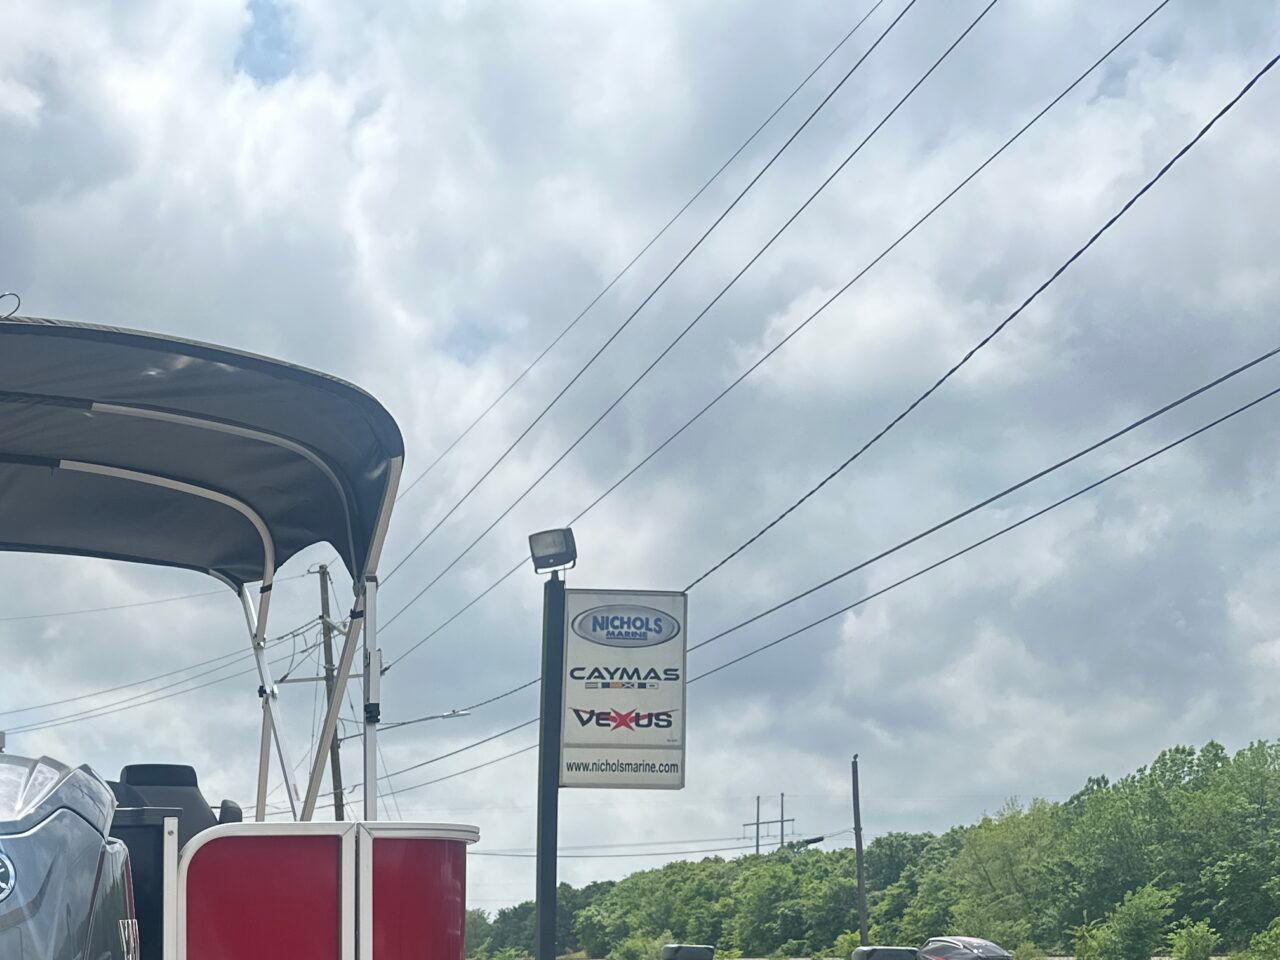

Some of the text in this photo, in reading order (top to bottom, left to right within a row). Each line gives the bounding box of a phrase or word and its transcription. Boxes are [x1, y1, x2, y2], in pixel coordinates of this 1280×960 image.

[592, 615, 663, 635] NICHOLS
[605, 630, 648, 639] MARINE
[569, 667, 680, 681] CAYMAS
[570, 707, 675, 732] VEXUS
[566, 759, 679, 774] www.nicholsmarine.com
